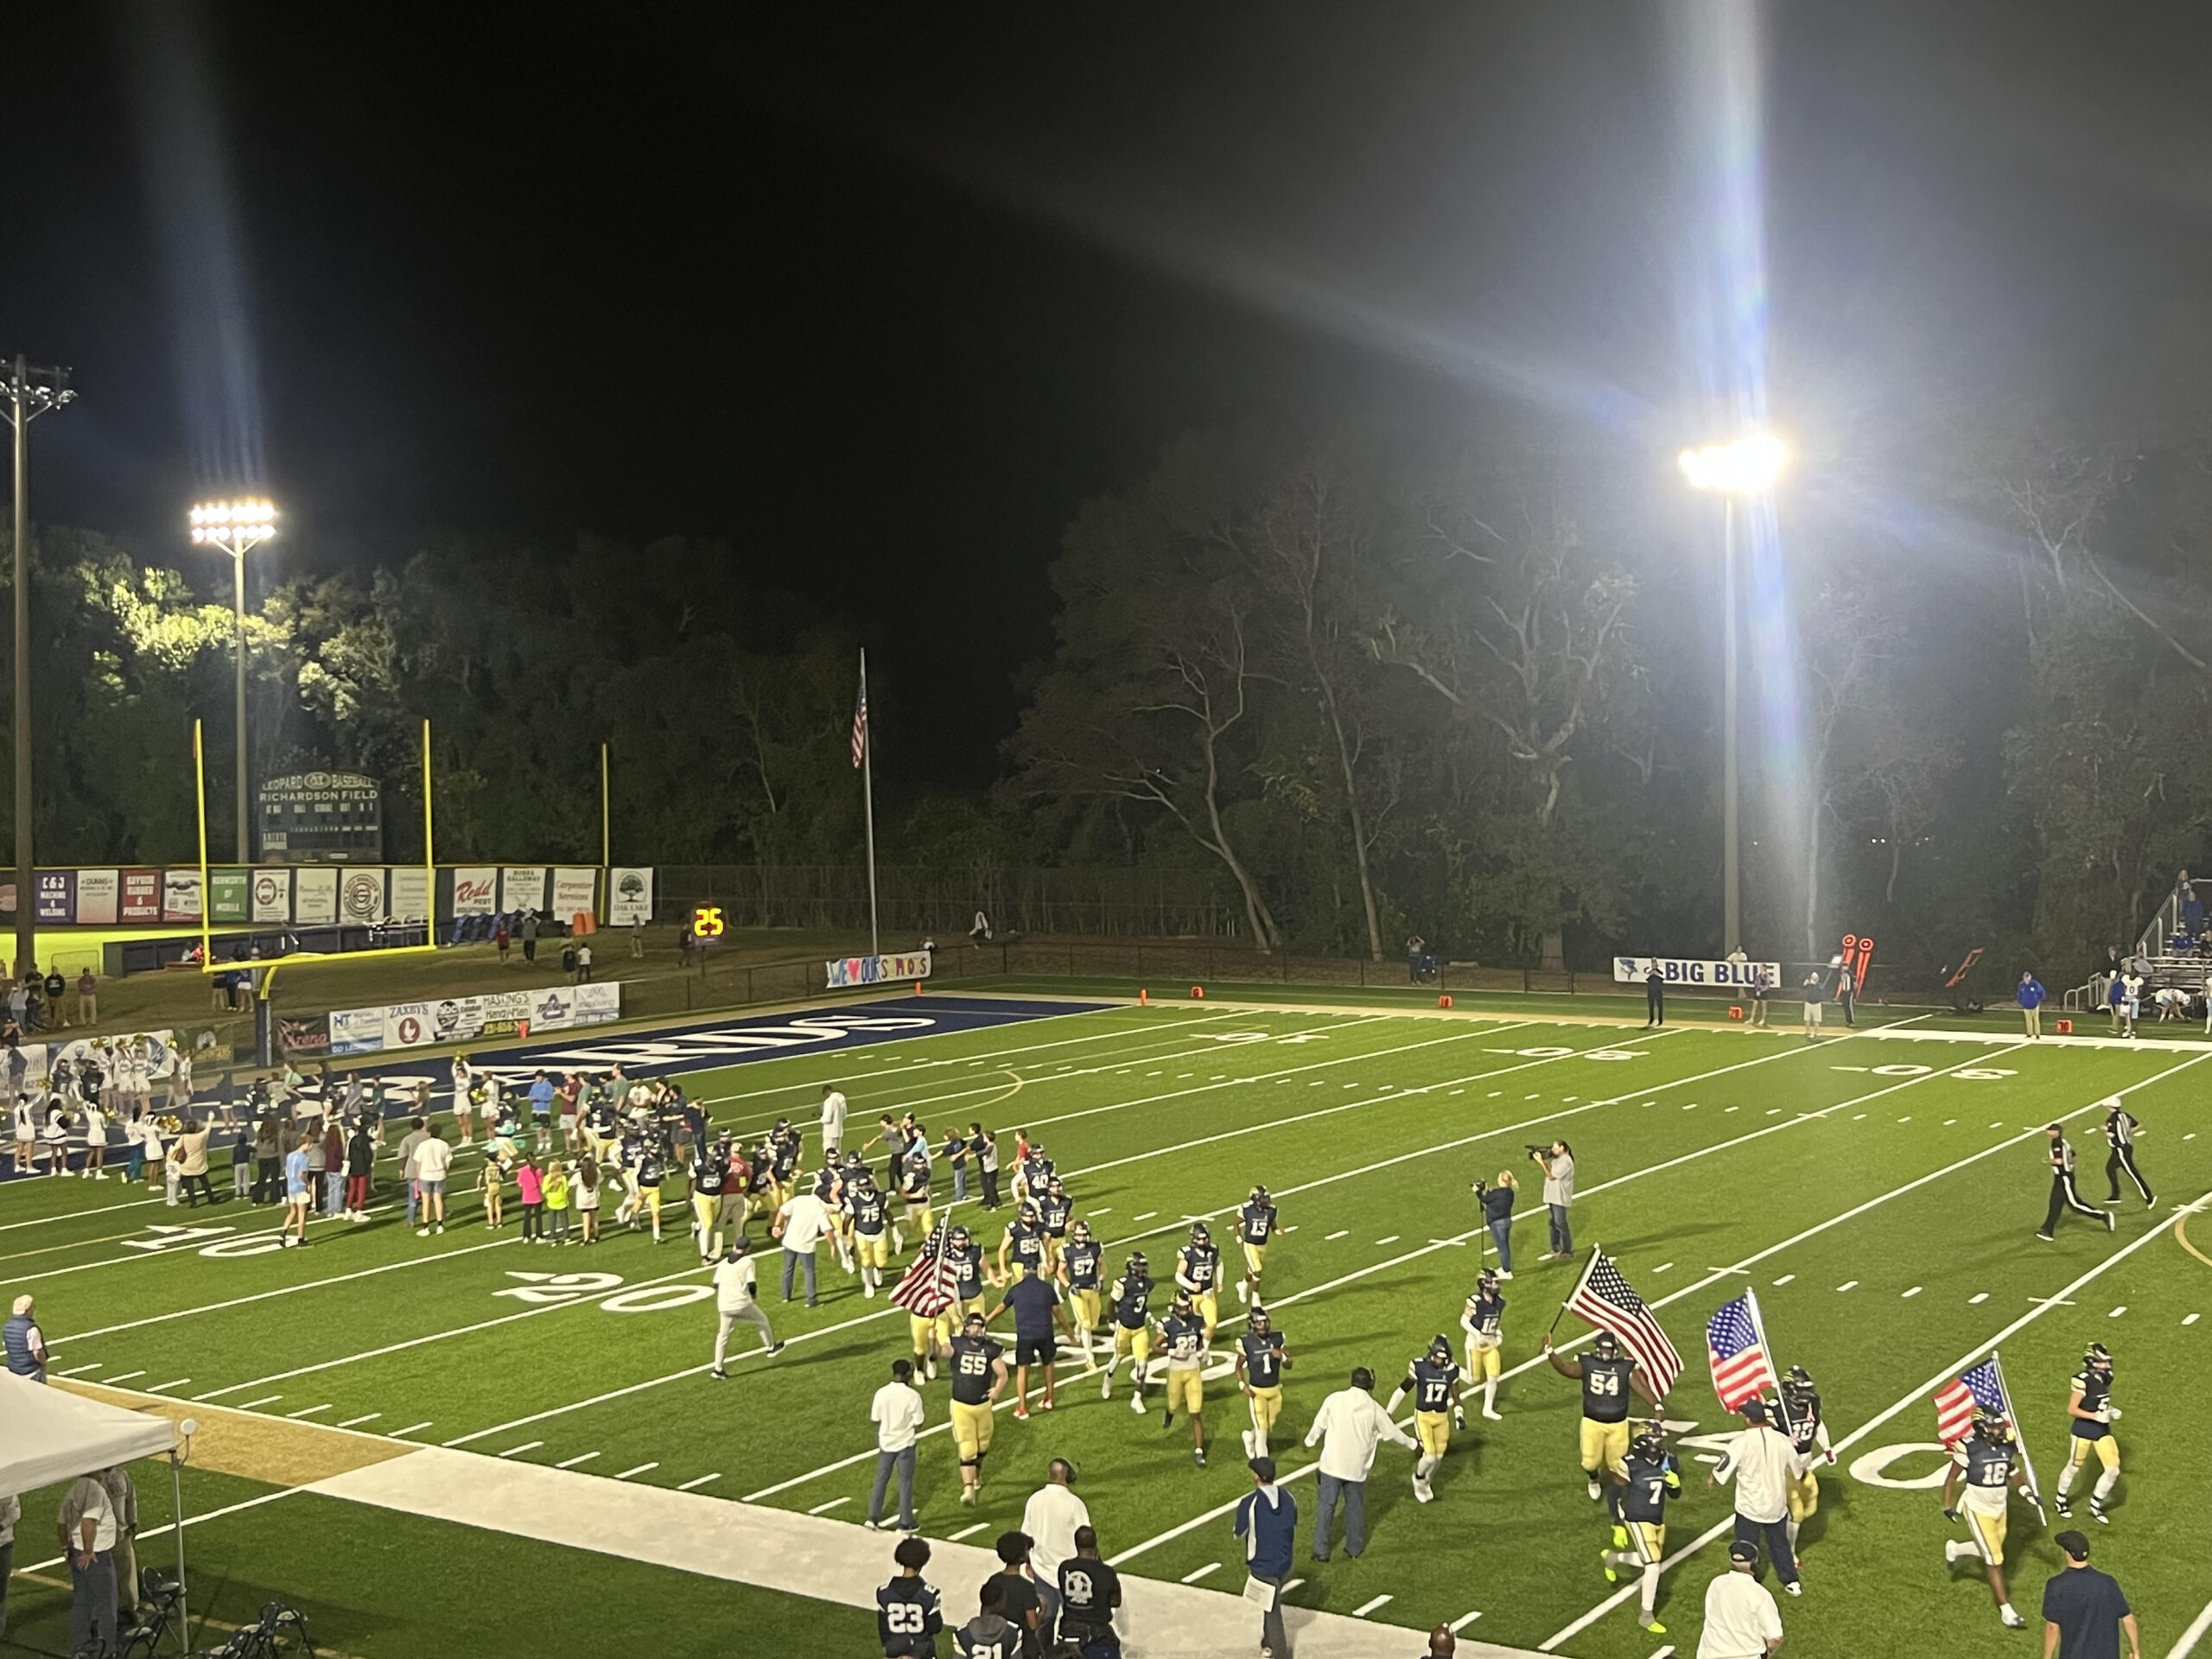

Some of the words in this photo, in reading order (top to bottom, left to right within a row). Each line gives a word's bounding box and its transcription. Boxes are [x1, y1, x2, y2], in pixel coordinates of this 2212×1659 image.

[263, 775, 302, 791] LEOPARD
[332, 774, 373, 788] BASEBALL
[259, 791, 339, 801] RICHARDSON
[341, 790, 378, 799] FIELD
[456, 878, 495, 904] Redd
[694, 907, 724, 937] 25
[830, 958, 847, 986] WE
[861, 957, 881, 982] OUR
[1666, 962, 1705, 982] BIG
[389, 1003, 429, 1019] ZAXBY'S
[1032, 1174, 1048, 1189] 40
[861, 1207, 880, 1223] 75
[1048, 1212, 1065, 1228] 15
[1134, 1296, 1146, 1313] 3
[960, 1355, 987, 1376] 55
[1263, 1353, 1272, 1374] 1
[1425, 1382, 1447, 1402] 17
[1590, 1373, 1618, 1396] 54
[1649, 1480, 1662, 1504] 7
[887, 1603, 925, 1634] 23
